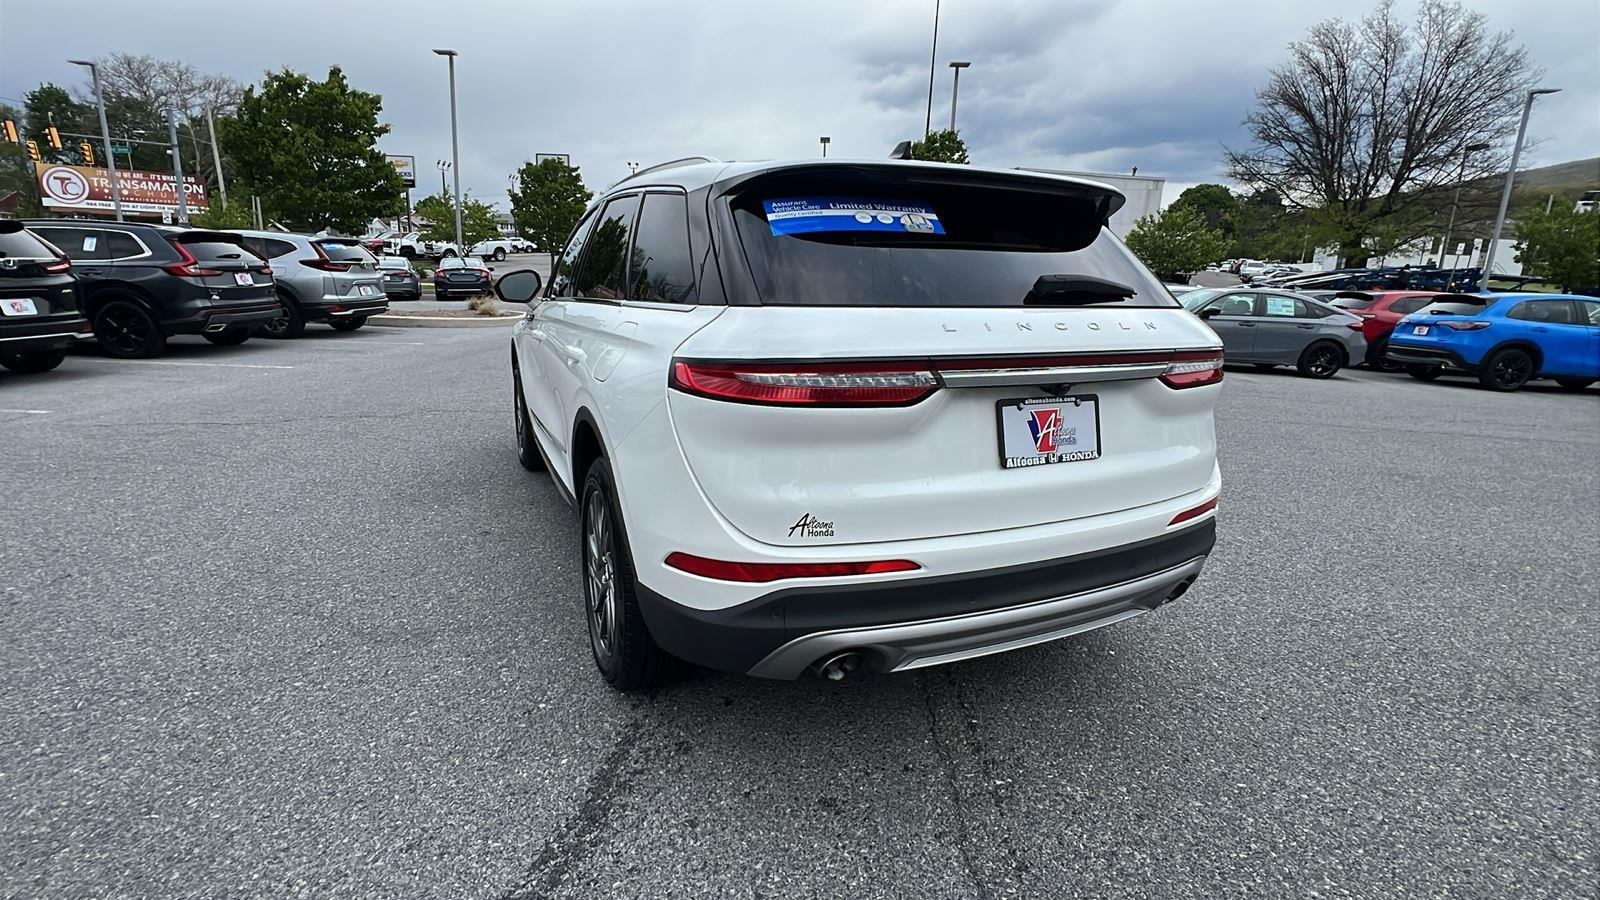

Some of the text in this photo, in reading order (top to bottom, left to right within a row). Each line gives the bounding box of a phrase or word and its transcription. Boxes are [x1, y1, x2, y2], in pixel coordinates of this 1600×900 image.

[91, 177, 204, 194] TRNS4MATON
[133, 189, 205, 200] CHURCH
[771, 200, 808, 208] Assurant
[873, 204, 926, 213] Warranty
[942, 321, 1158, 333] LINCOLN
[1006, 451, 1099, 469] Altoona HONDA
[788, 512, 834, 538] Altoona
[807, 529, 835, 538] Honda
